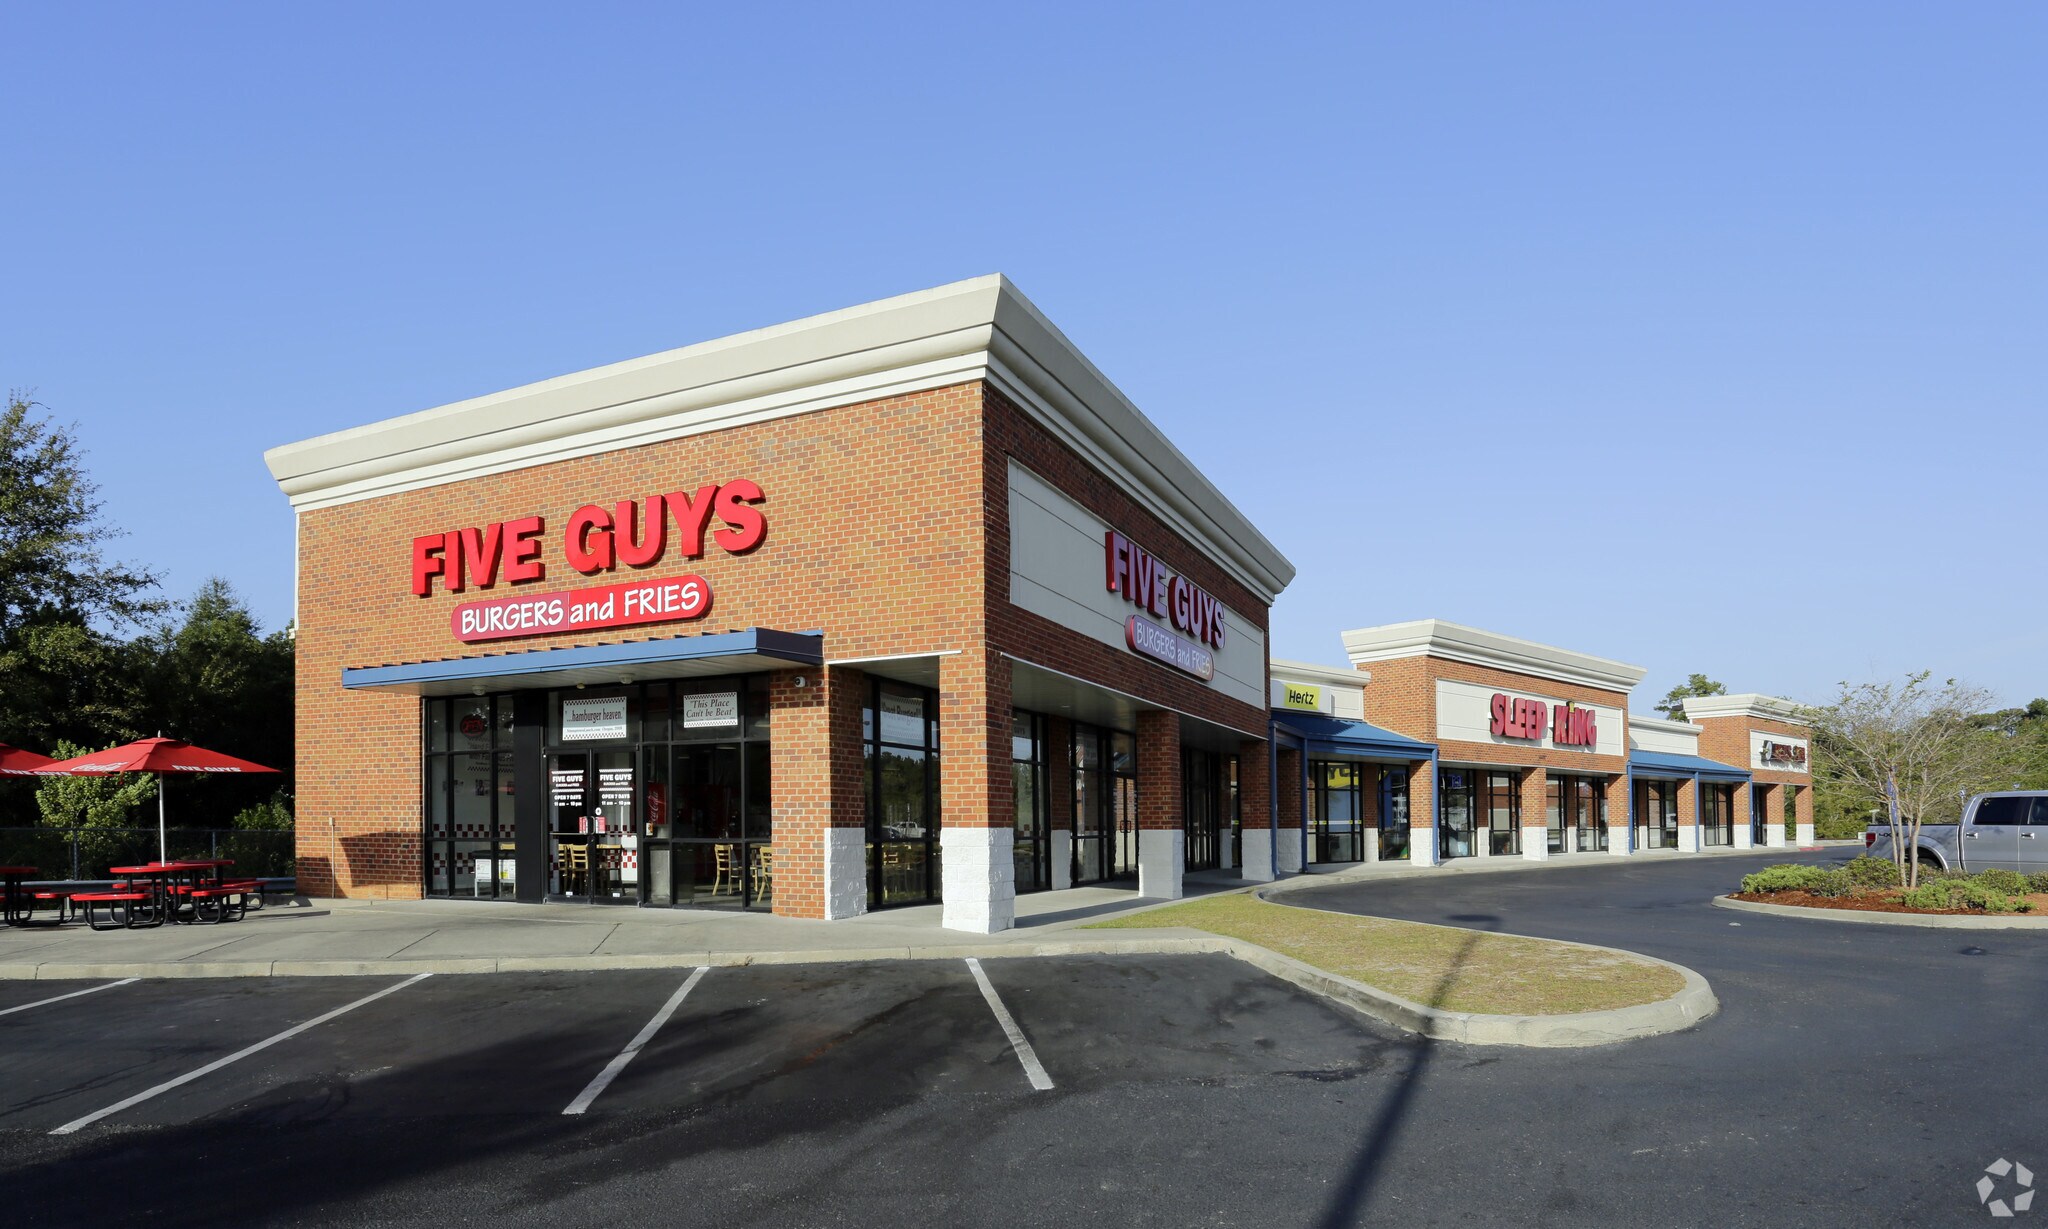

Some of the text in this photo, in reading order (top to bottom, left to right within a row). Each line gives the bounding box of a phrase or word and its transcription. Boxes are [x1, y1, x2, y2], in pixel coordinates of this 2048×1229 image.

[412, 479, 767, 597] FIVE GUYS
[461, 582, 700, 635] BURGERS and FRIES
[1105, 531, 1225, 649] FIVE GUYS
[1136, 621, 1211, 676] BURGERS and FRIES
[705, 709, 713, 717] be
[711, 699, 729, 707] Place
[1288, 689, 1315, 705] Hertz
[1490, 693, 1548, 739] SLEEP
